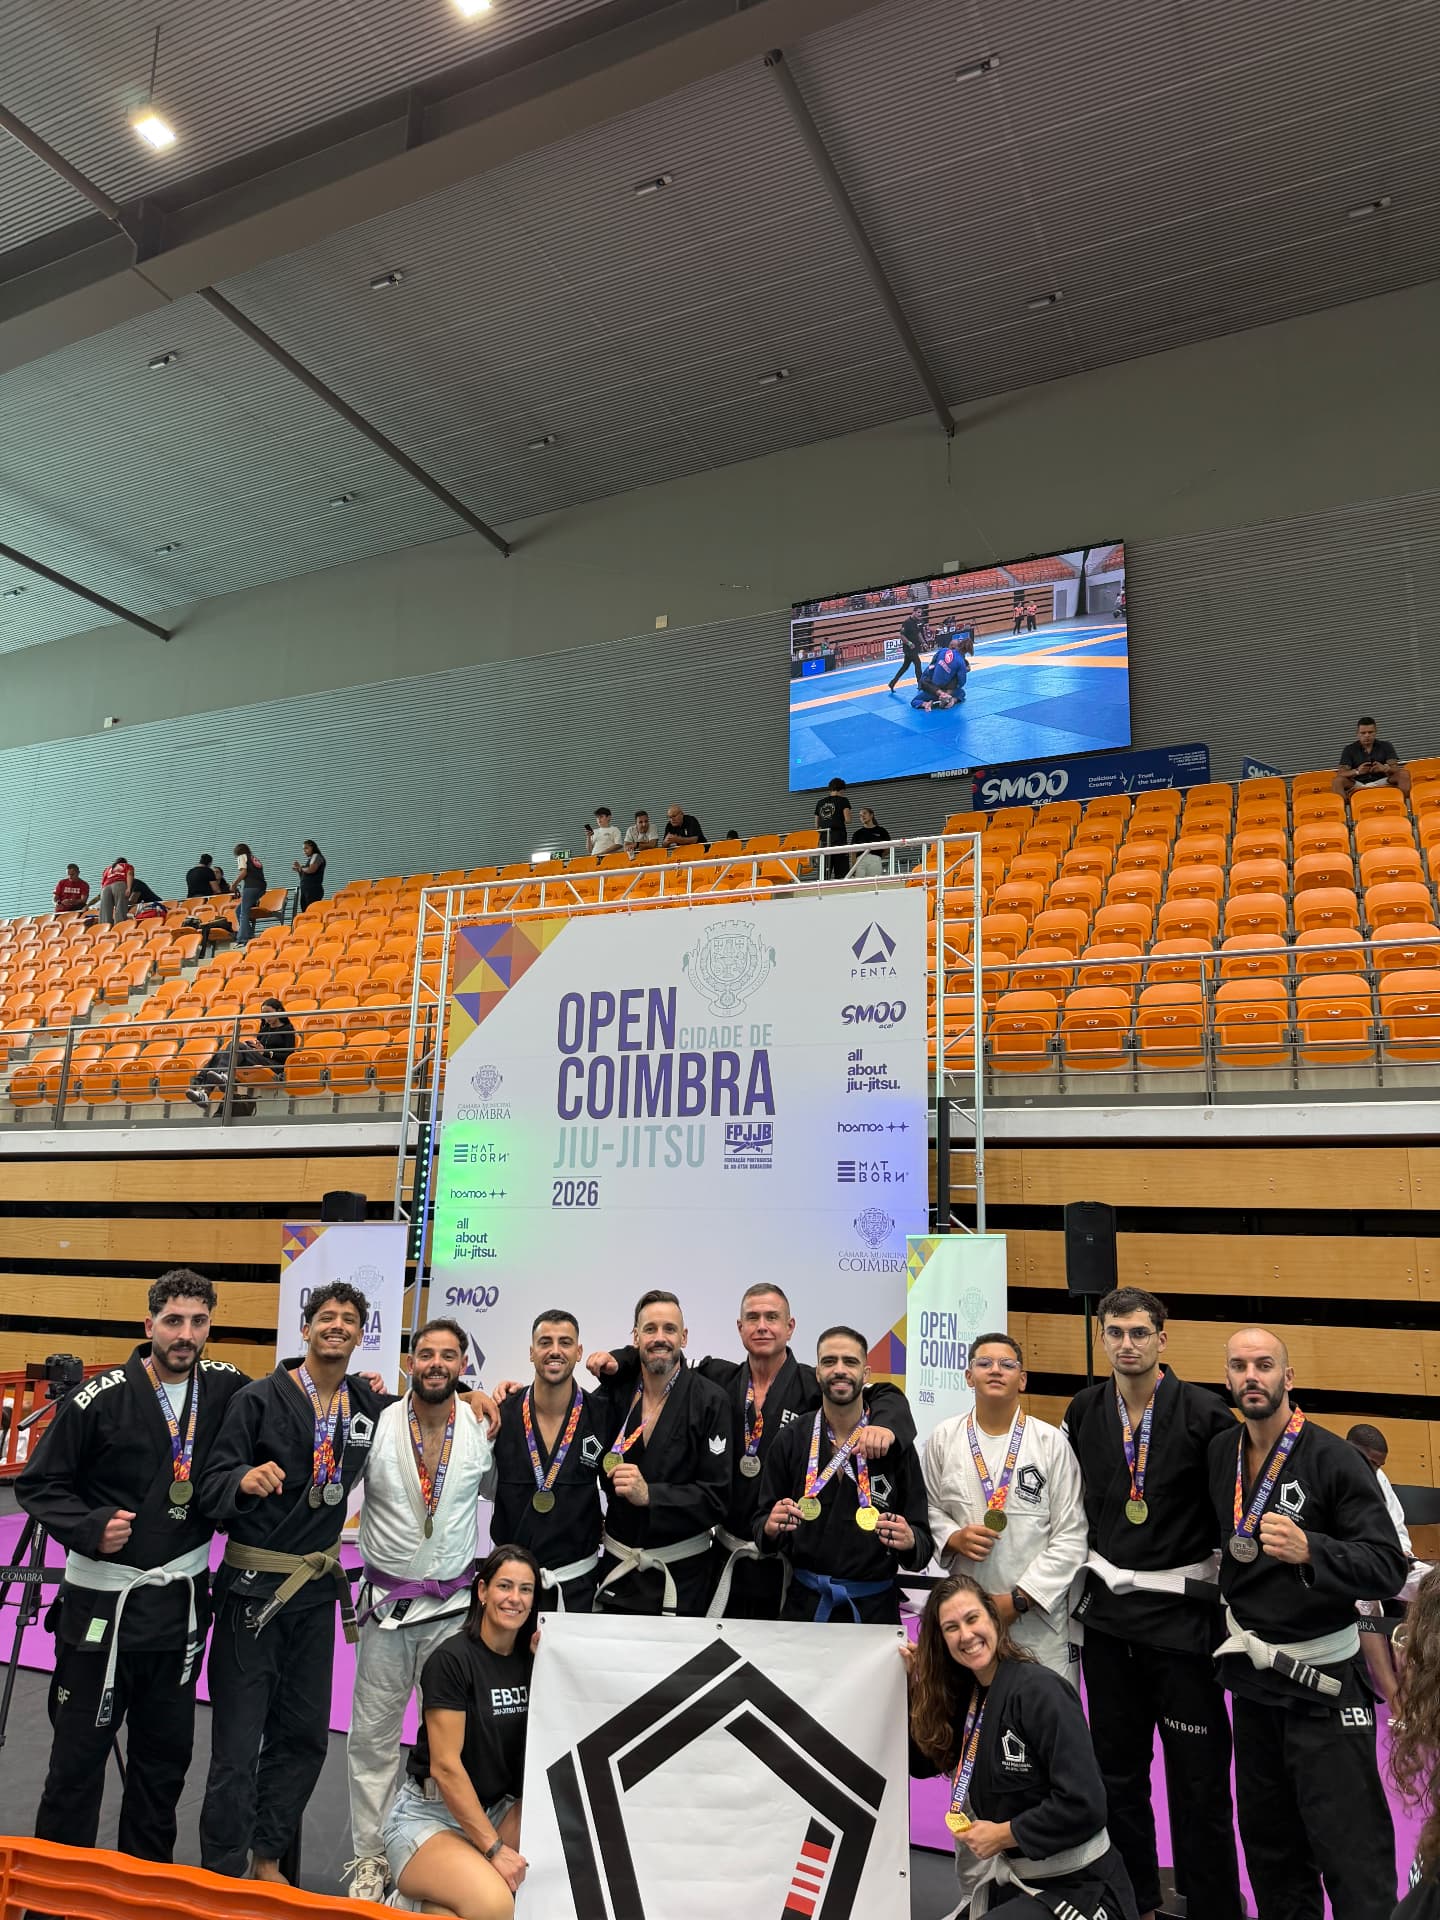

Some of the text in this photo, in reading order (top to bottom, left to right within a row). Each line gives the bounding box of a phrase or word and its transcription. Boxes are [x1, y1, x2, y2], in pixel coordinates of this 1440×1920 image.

[981, 769, 1069, 805] SMOO
[1088, 774, 1117, 783] Delicious
[851, 966, 897, 978] PENTA
[557, 986, 677, 1055] OPEN
[841, 1000, 907, 1025] SMOO
[679, 1024, 773, 1050] CIDADE DE
[847, 1048, 863, 1061] all
[847, 1063, 888, 1075] about
[557, 1049, 776, 1120] COIMBRA
[846, 1077, 901, 1093] jiu-jitsu.
[457, 1108, 511, 1121] COIMBRA
[726, 1124, 772, 1141] FPJJB
[471, 1143, 495, 1152] MAT
[553, 1124, 706, 1169] JIU-JITSU
[859, 1161, 889, 1171] MAT
[552, 1180, 599, 1207] 2026
[456, 1217, 469, 1229] all
[455, 1232, 488, 1244] about
[453, 1245, 497, 1260] jiu-jitsu.
[838, 1258, 908, 1273] COIMBRA
[445, 1285, 499, 1308] SMOO
[920, 1311, 958, 1341] OPEN
[920, 1339, 969, 1371] COIMB
[199, 1359, 241, 1376] FOO
[919, 1368, 967, 1391] JIU-JITSU
[73, 1368, 127, 1411] BEAR
[918, 1391, 935, 1403] 2026
[1243, 1451, 1288, 1533] OPEN CIDADE DE COIMBRA
[1, 1571, 44, 1582] COIMBRA
[490, 1686, 528, 1707] EBJJ
[954, 1771, 970, 1801] CIDADE
[964, 1760, 974, 1773] DE
